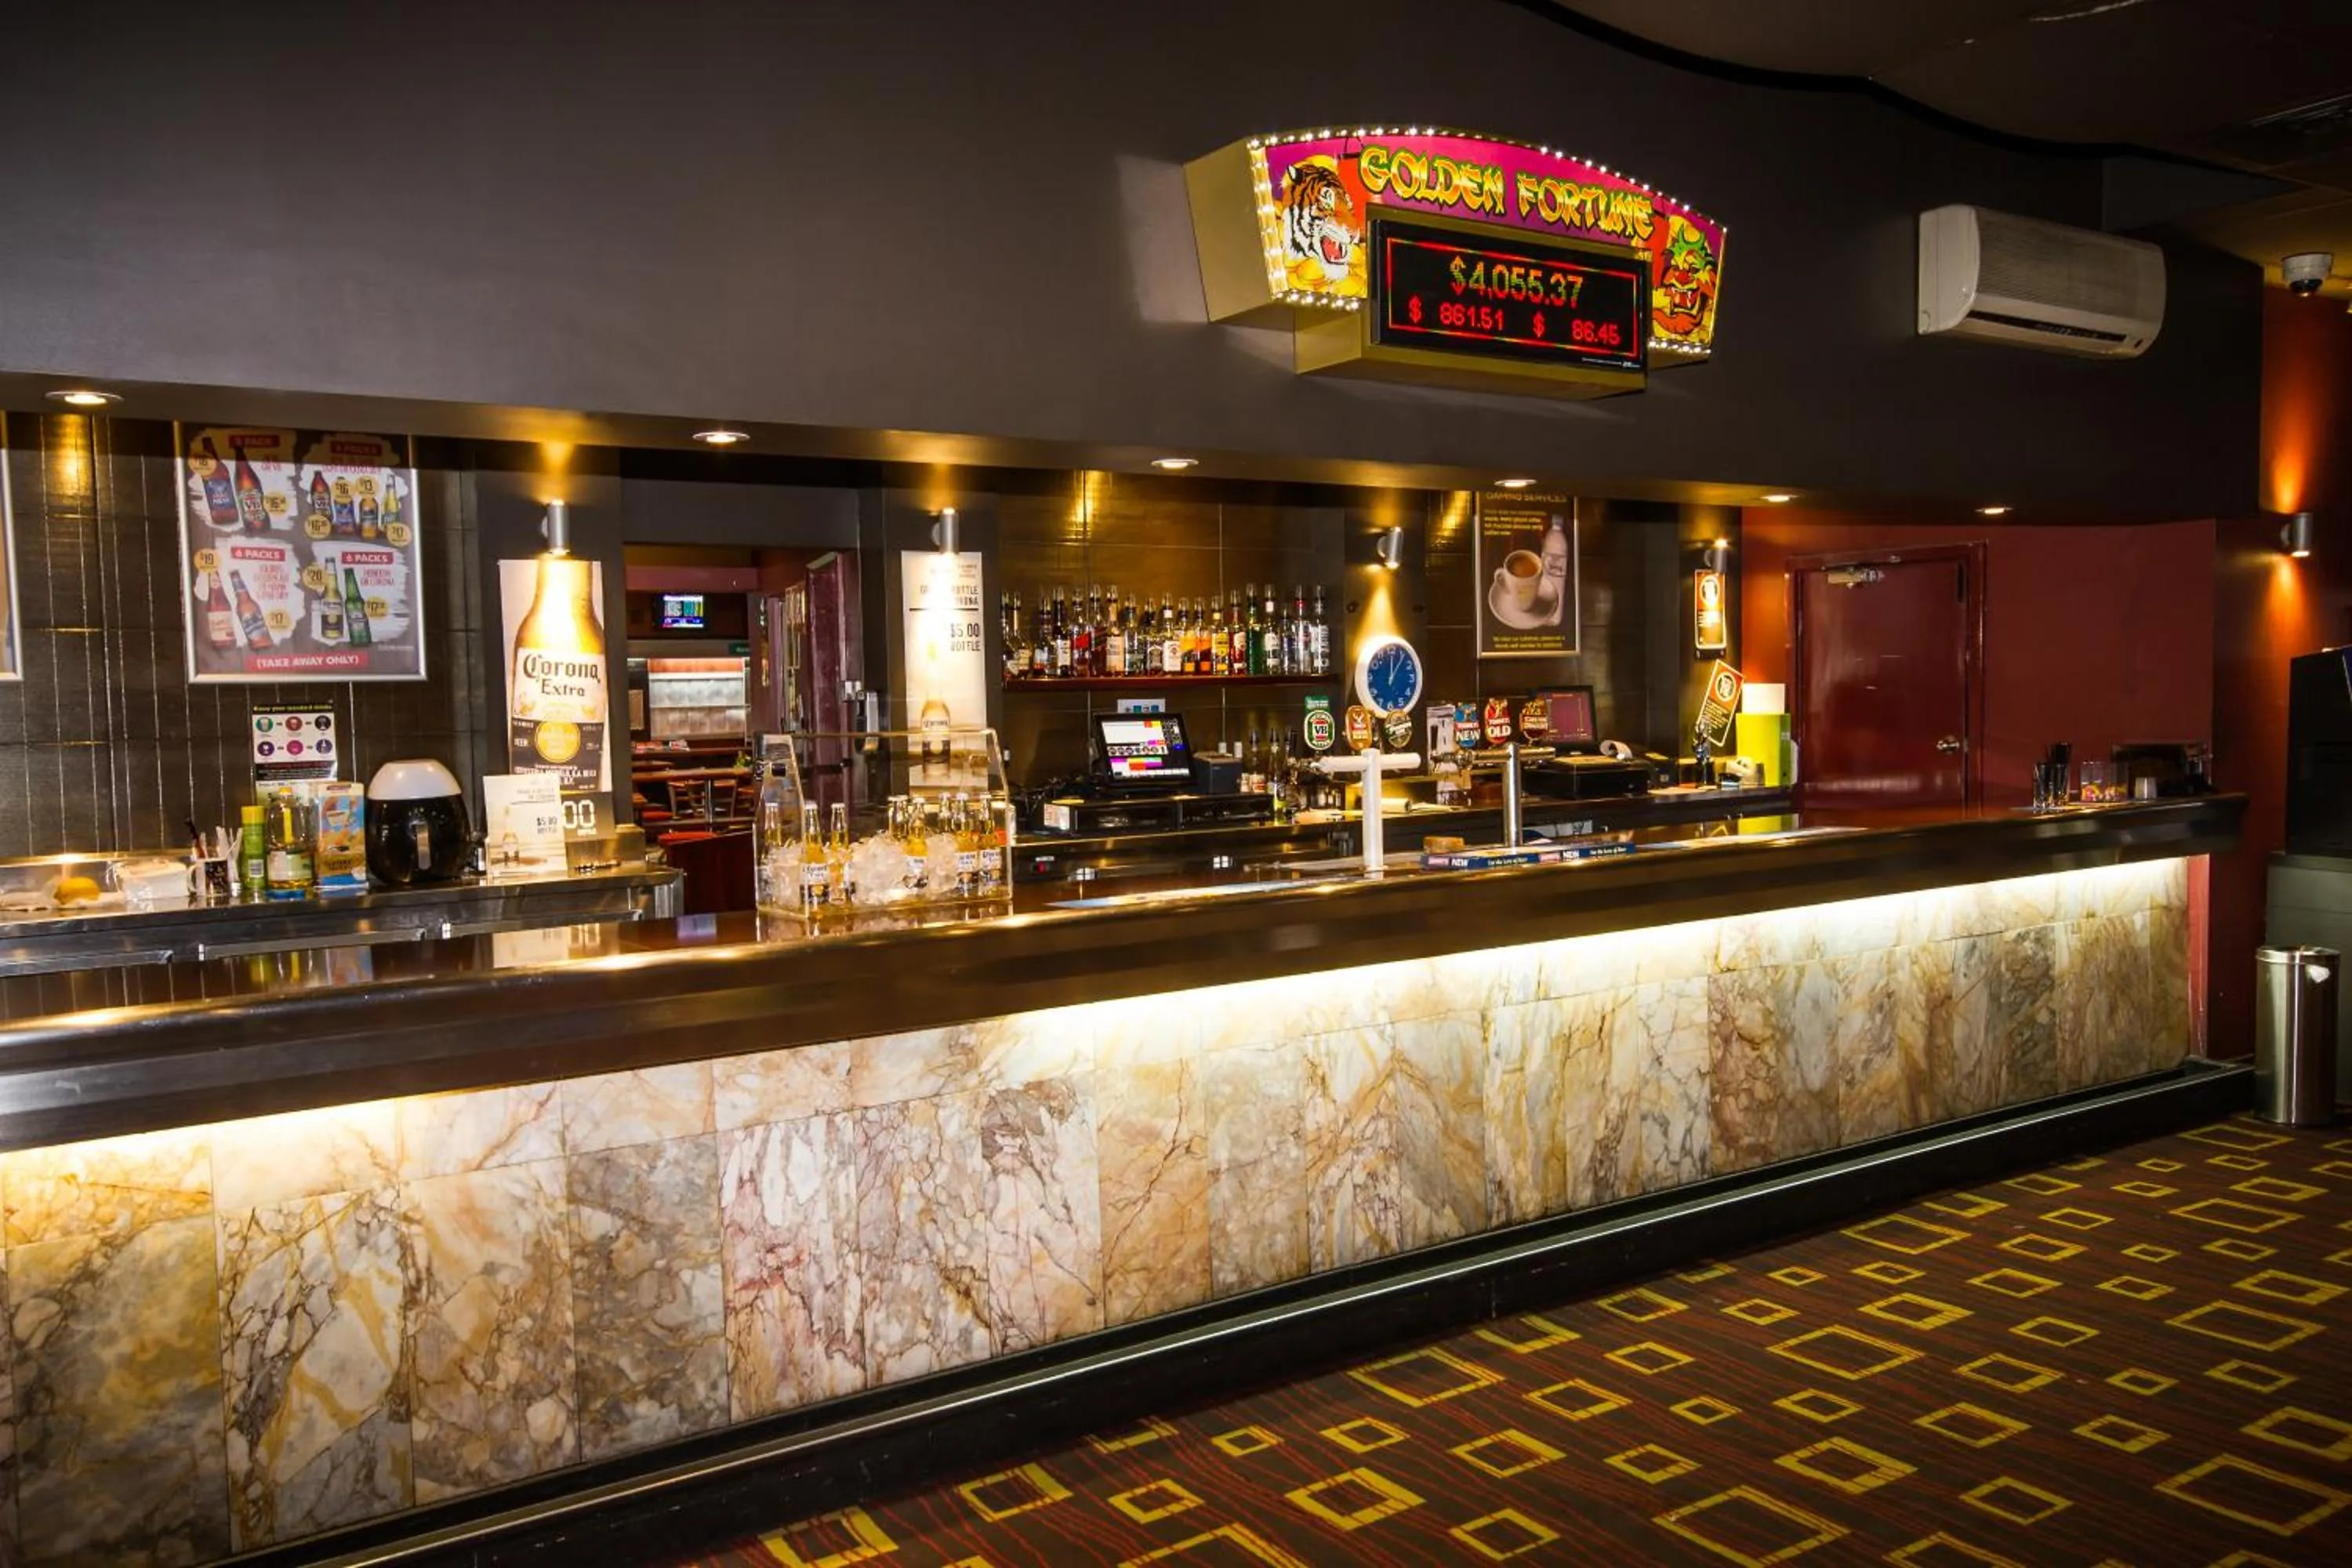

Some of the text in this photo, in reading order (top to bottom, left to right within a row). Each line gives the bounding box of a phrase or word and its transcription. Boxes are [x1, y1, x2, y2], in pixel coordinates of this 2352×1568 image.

[1359, 147, 1654, 239] GOLDEN FORTUNE
[1408, 294, 1504, 331] $ 861.51
[1532, 311, 1622, 346] $ 86.45
[354, 554, 389, 563] PACKS
[292, 657, 322, 666] AWAY
[523, 653, 601, 684] Corona
[541, 679, 586, 697] Extra
[1314, 725, 1327, 735] VB
[1455, 728, 1481, 741] NEW
[1486, 725, 1512, 738] OLD
